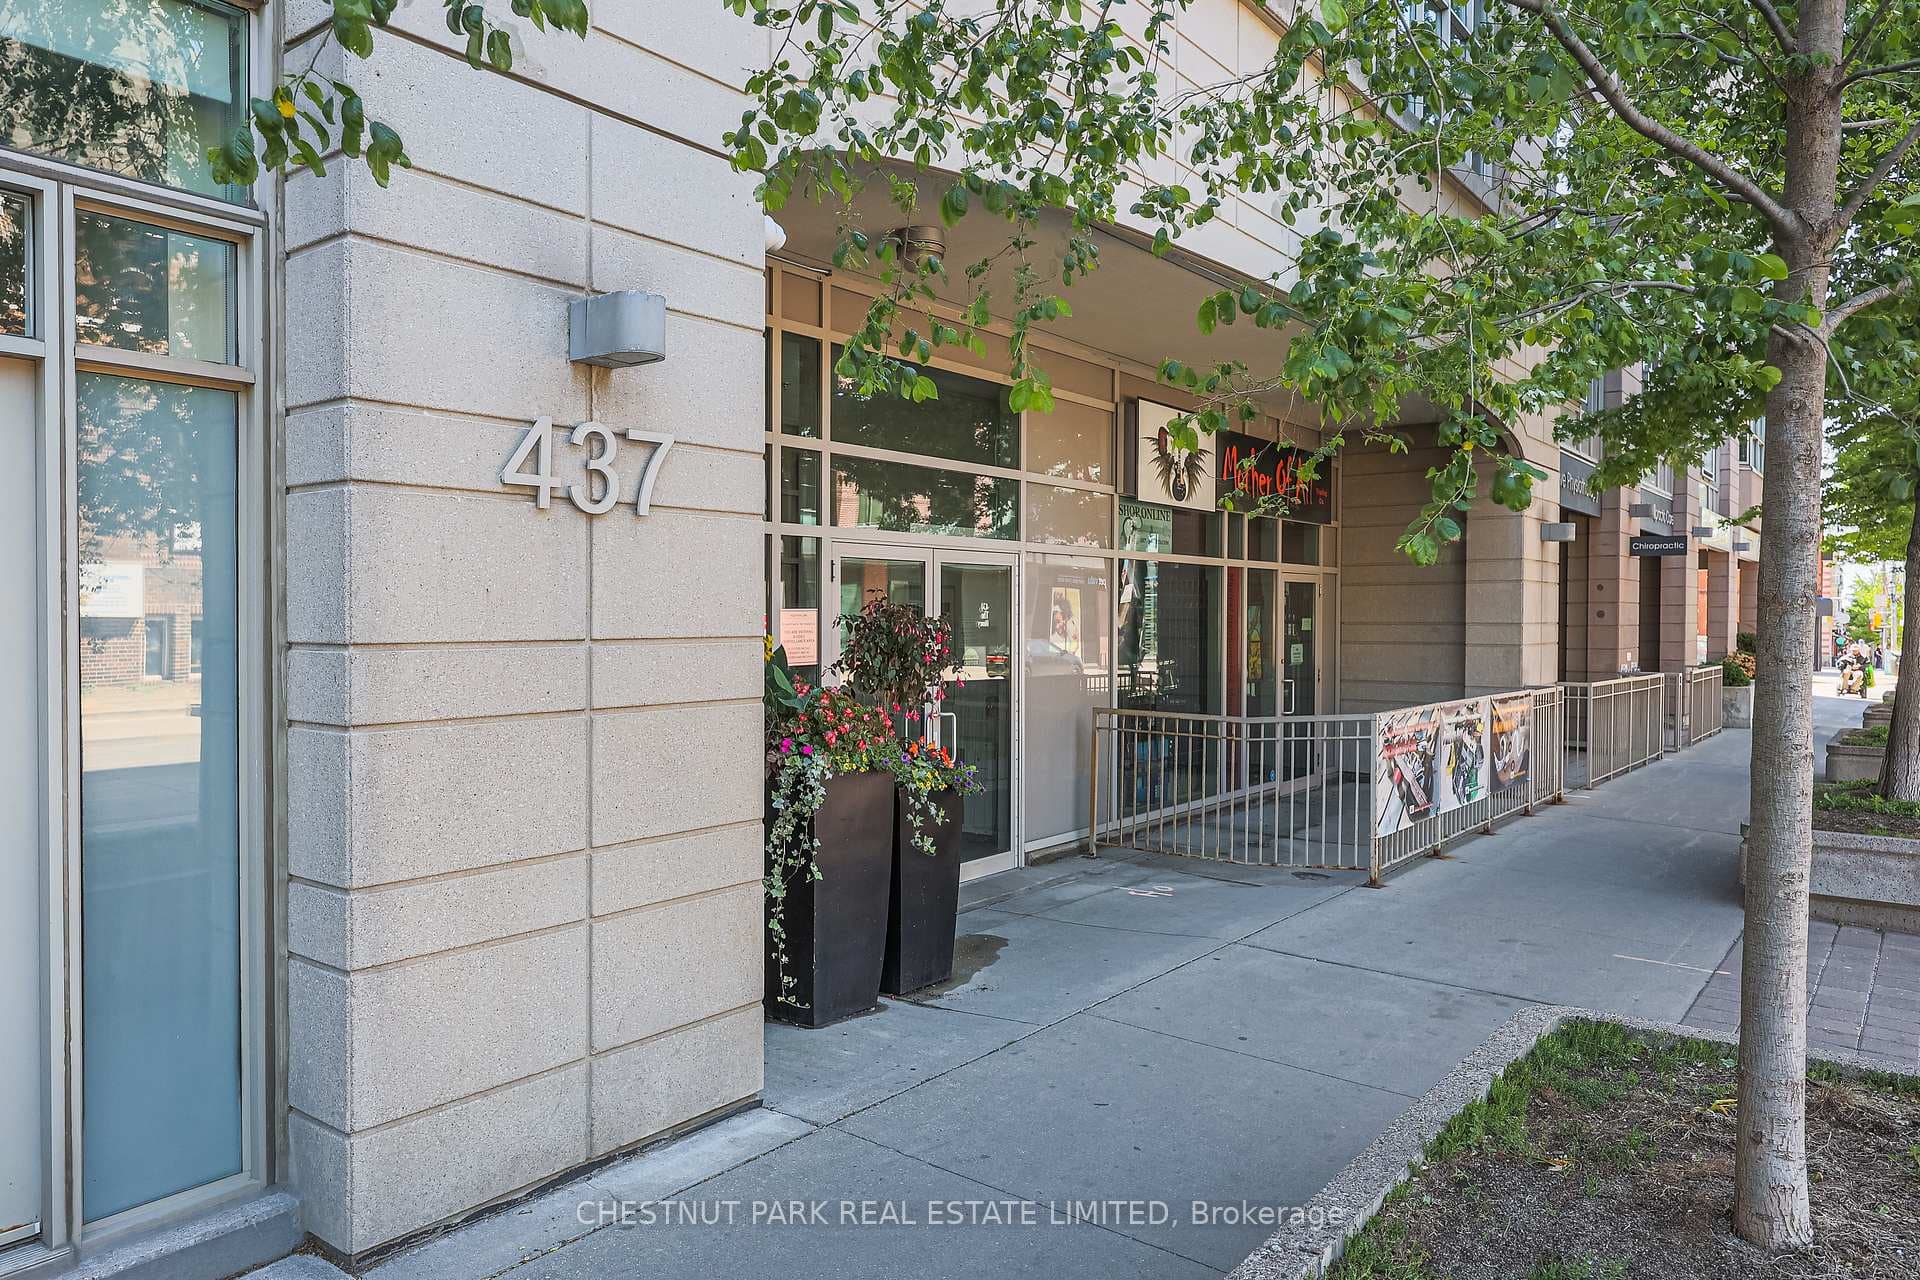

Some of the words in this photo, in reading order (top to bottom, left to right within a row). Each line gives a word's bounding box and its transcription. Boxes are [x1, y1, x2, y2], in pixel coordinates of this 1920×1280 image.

[501, 415, 675, 516] 437
[1140, 506, 1171, 522] ONLINE
[1632, 542, 1685, 551] Chiropractic
